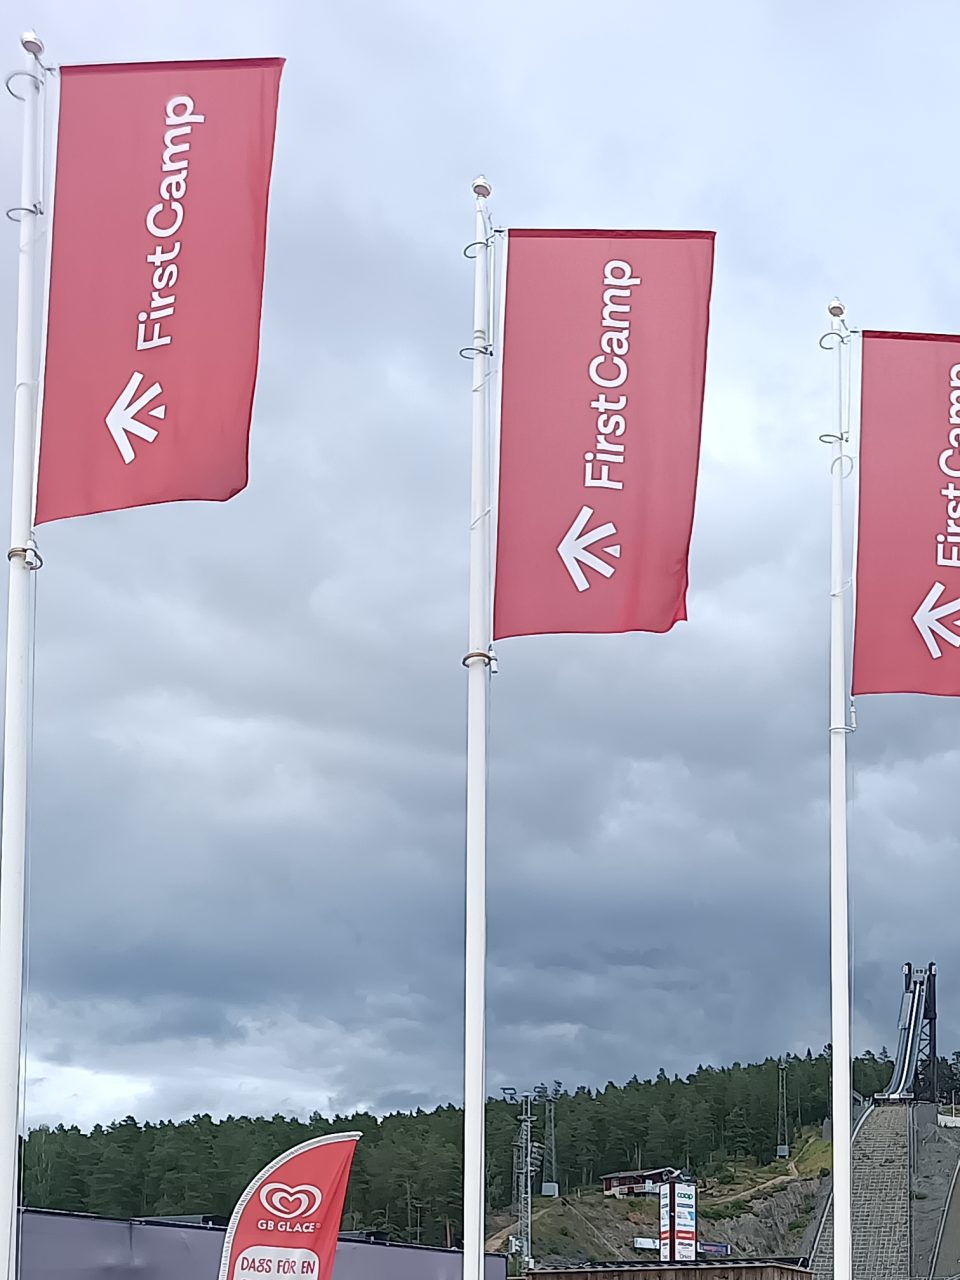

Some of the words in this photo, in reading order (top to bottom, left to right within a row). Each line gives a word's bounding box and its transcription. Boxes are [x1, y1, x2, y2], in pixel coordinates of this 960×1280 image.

[146, 94, 205, 238] Camp
[137, 241, 181, 351] First
[589, 259, 641, 388] Camp
[584, 394, 627, 490] First
[257, 1219, 275, 1230] GB
[277, 1221, 315, 1232] GLACE
[276, 1257, 297, 1275] FÖR
[301, 1260, 316, 1275] EN
